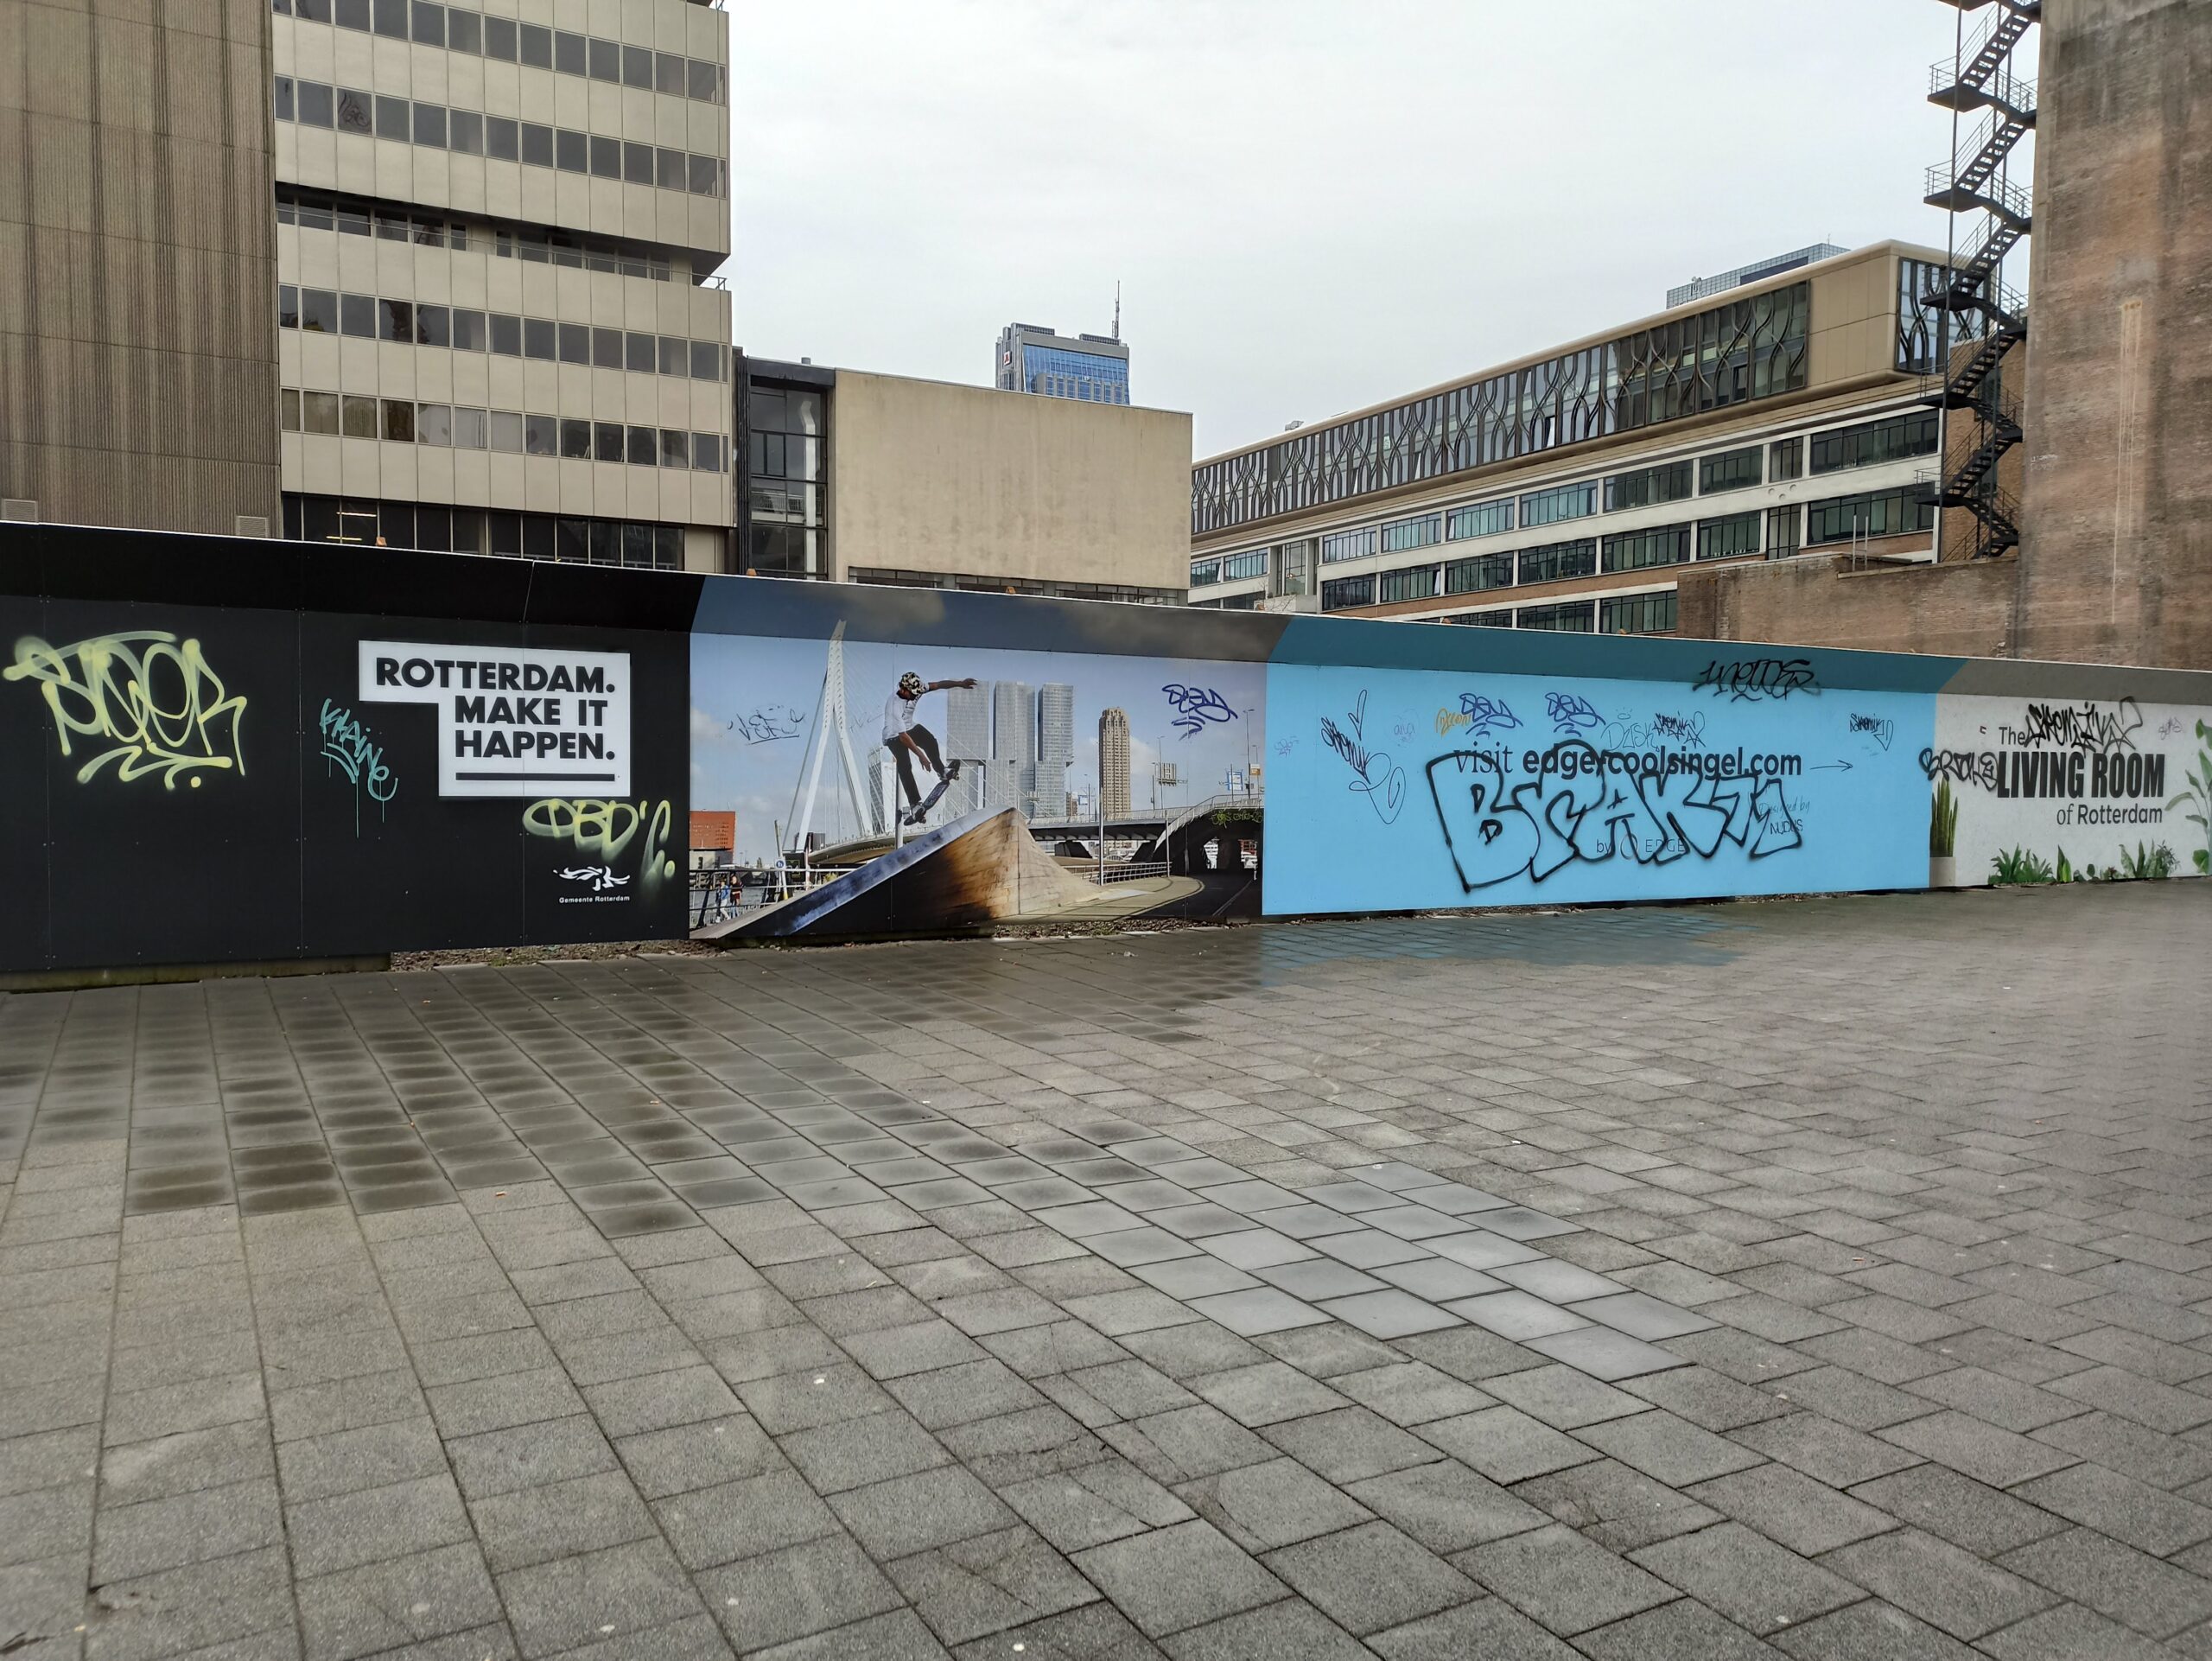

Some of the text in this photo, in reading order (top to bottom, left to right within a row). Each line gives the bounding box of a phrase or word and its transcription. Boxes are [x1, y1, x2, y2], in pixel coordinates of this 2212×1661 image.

[376, 657, 615, 693] ROTTERDAM.
[454, 695, 608, 727] MAKE IT
[454, 729, 615, 760] HAPPEN.
[1999, 726, 2024, 745] The
[1453, 741, 1514, 773] visit
[1997, 751, 2165, 799] LIVING ROOM
[2056, 803, 2163, 825] of Rotterdam
[1596, 838, 1613, 855] by
